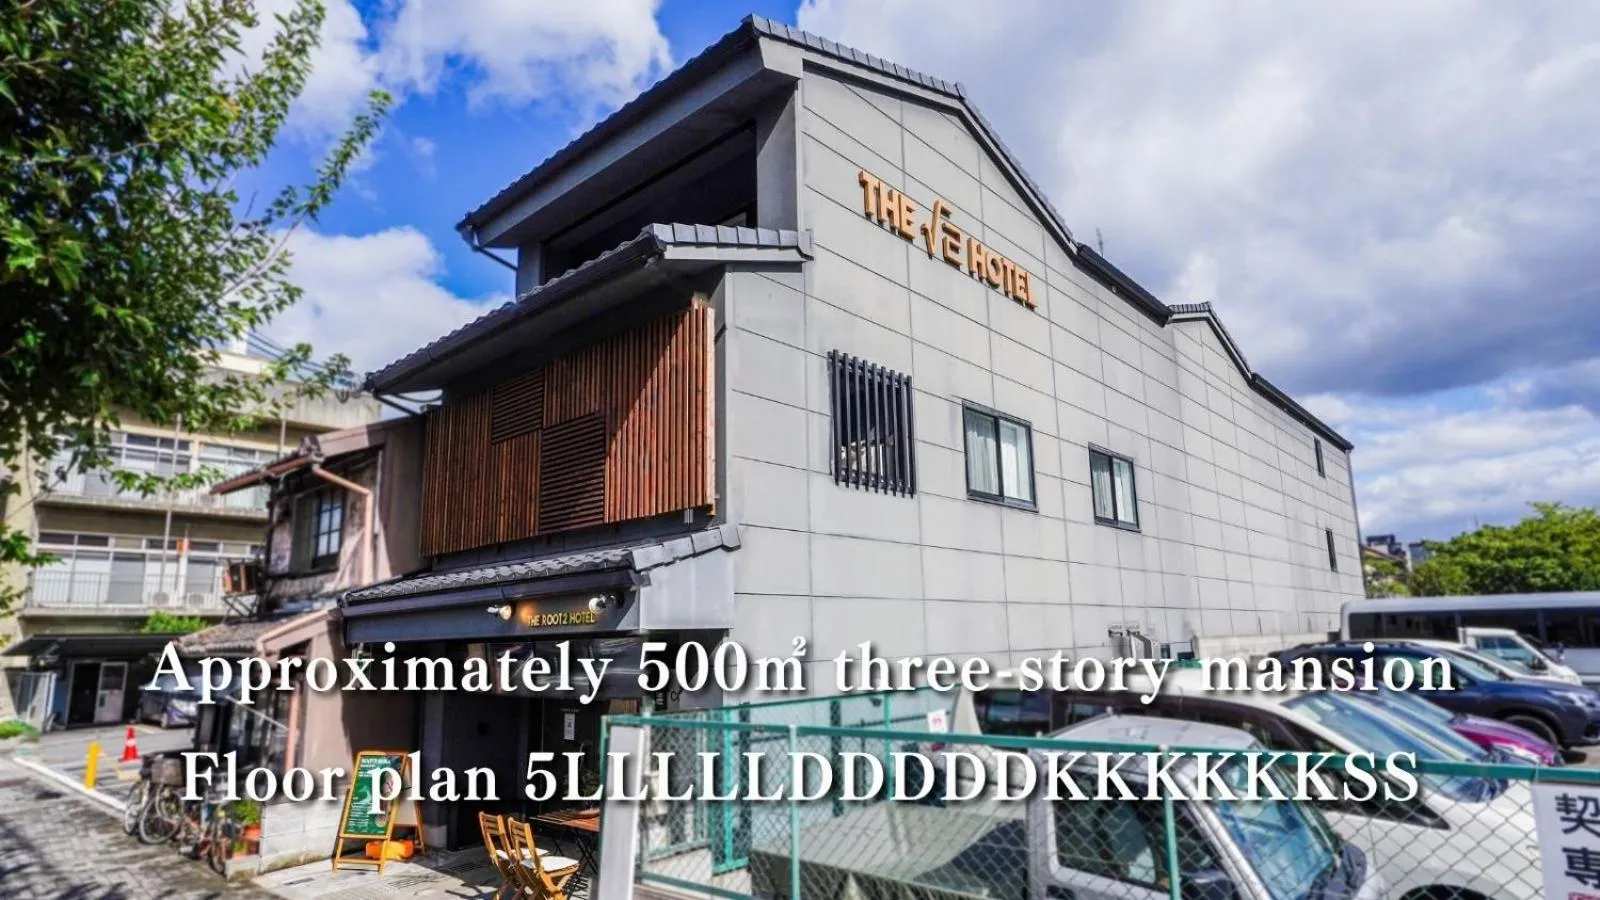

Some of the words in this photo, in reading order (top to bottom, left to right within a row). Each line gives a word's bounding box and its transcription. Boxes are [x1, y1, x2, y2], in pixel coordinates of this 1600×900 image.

[858, 169, 916, 244] THE
[966, 237, 1038, 311] HOTEL
[527, 615, 541, 627] THE
[541, 612, 569, 626] ROOT2
[569, 611, 596, 624] HOTEL
